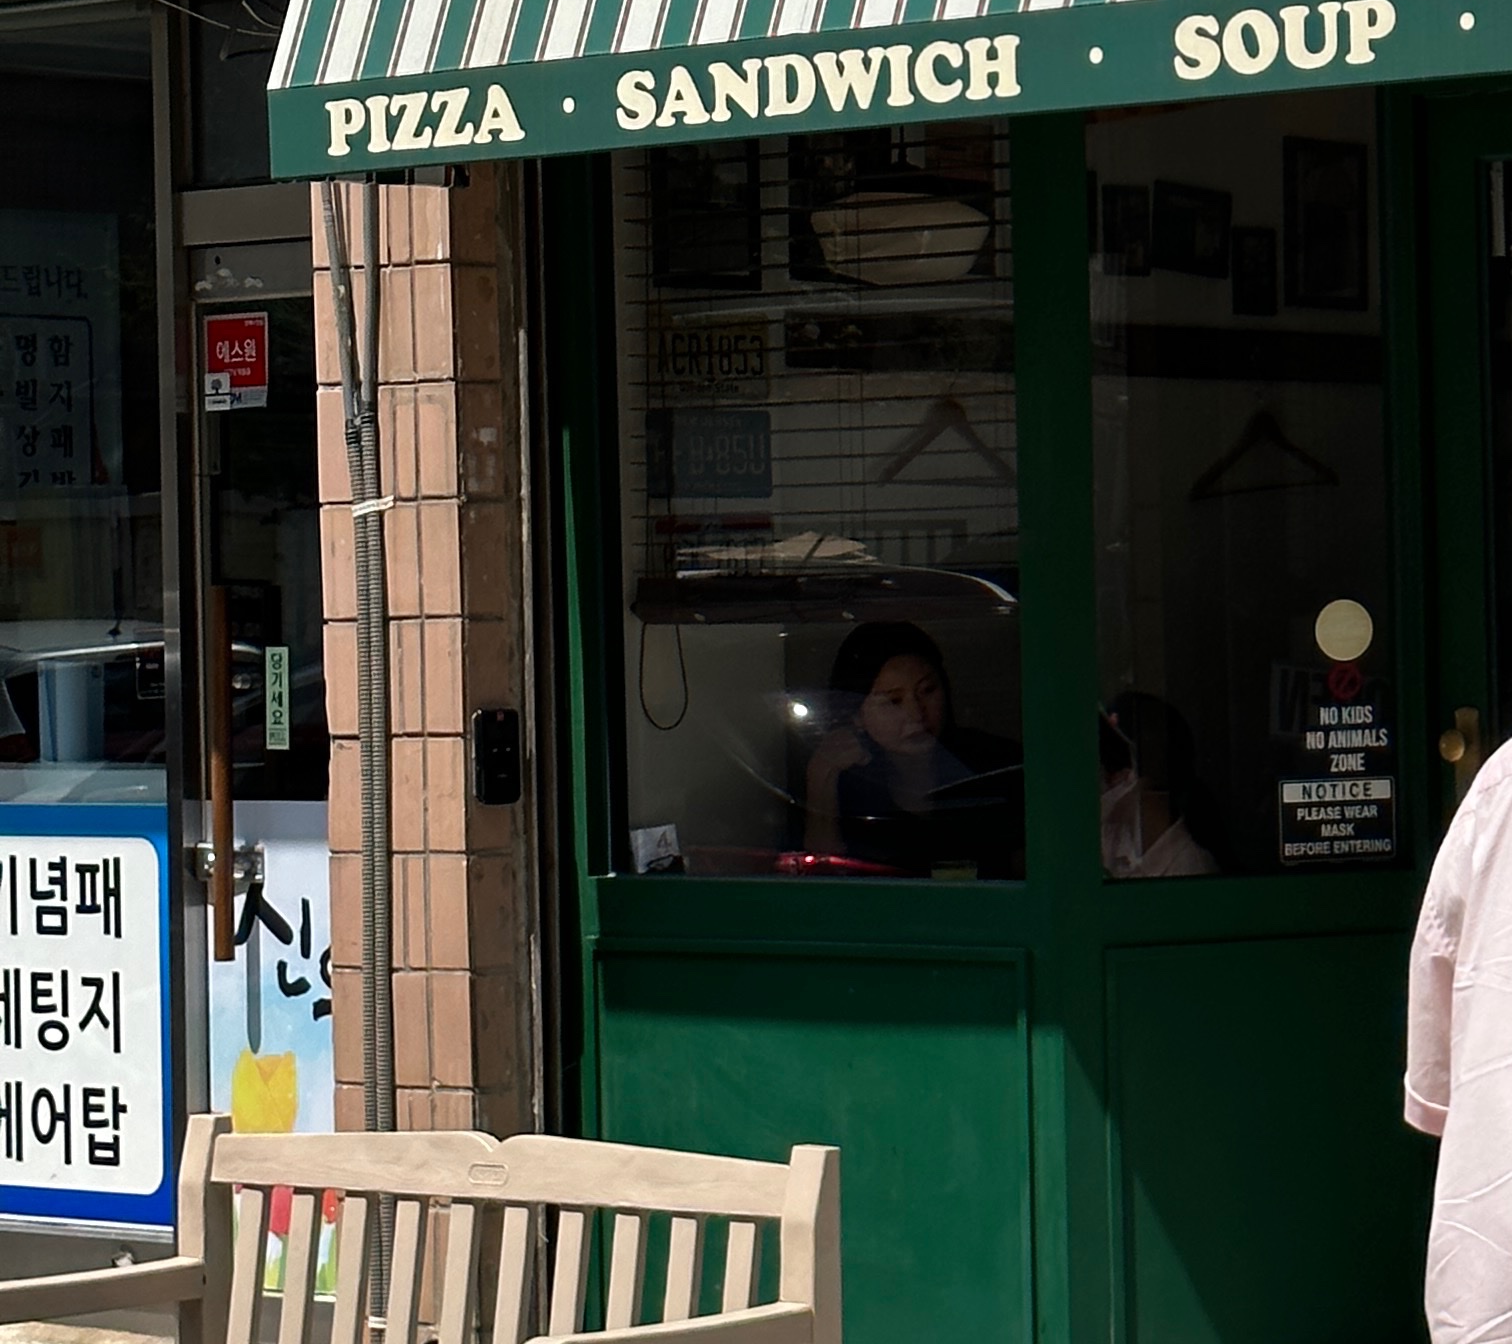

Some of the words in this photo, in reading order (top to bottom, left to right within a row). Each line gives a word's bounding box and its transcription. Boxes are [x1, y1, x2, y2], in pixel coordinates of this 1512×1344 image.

[323, 84, 526, 157] PIZZA
[614, 34, 1023, 132] SANDWICH
[215, 338, 257, 364] 에스원
[270, 652, 284, 726] 당기세요
[1319, 706, 1339, 726] NO
[1342, 705, 1374, 725] KIDS
[1305, 731, 1325, 750] NO
[1328, 728, 1388, 750] ANIMALS
[1330, 752, 1366, 773] ZONE
[1301, 781, 1374, 801] NOTICE
[1296, 806, 1342, 821] PLEASE
[1344, 805, 1378, 820] WEAR
[1320, 822, 1355, 838] MASK
[1284, 841, 1332, 857] BEFORE
[1333, 839, 1392, 855] ENTERING
